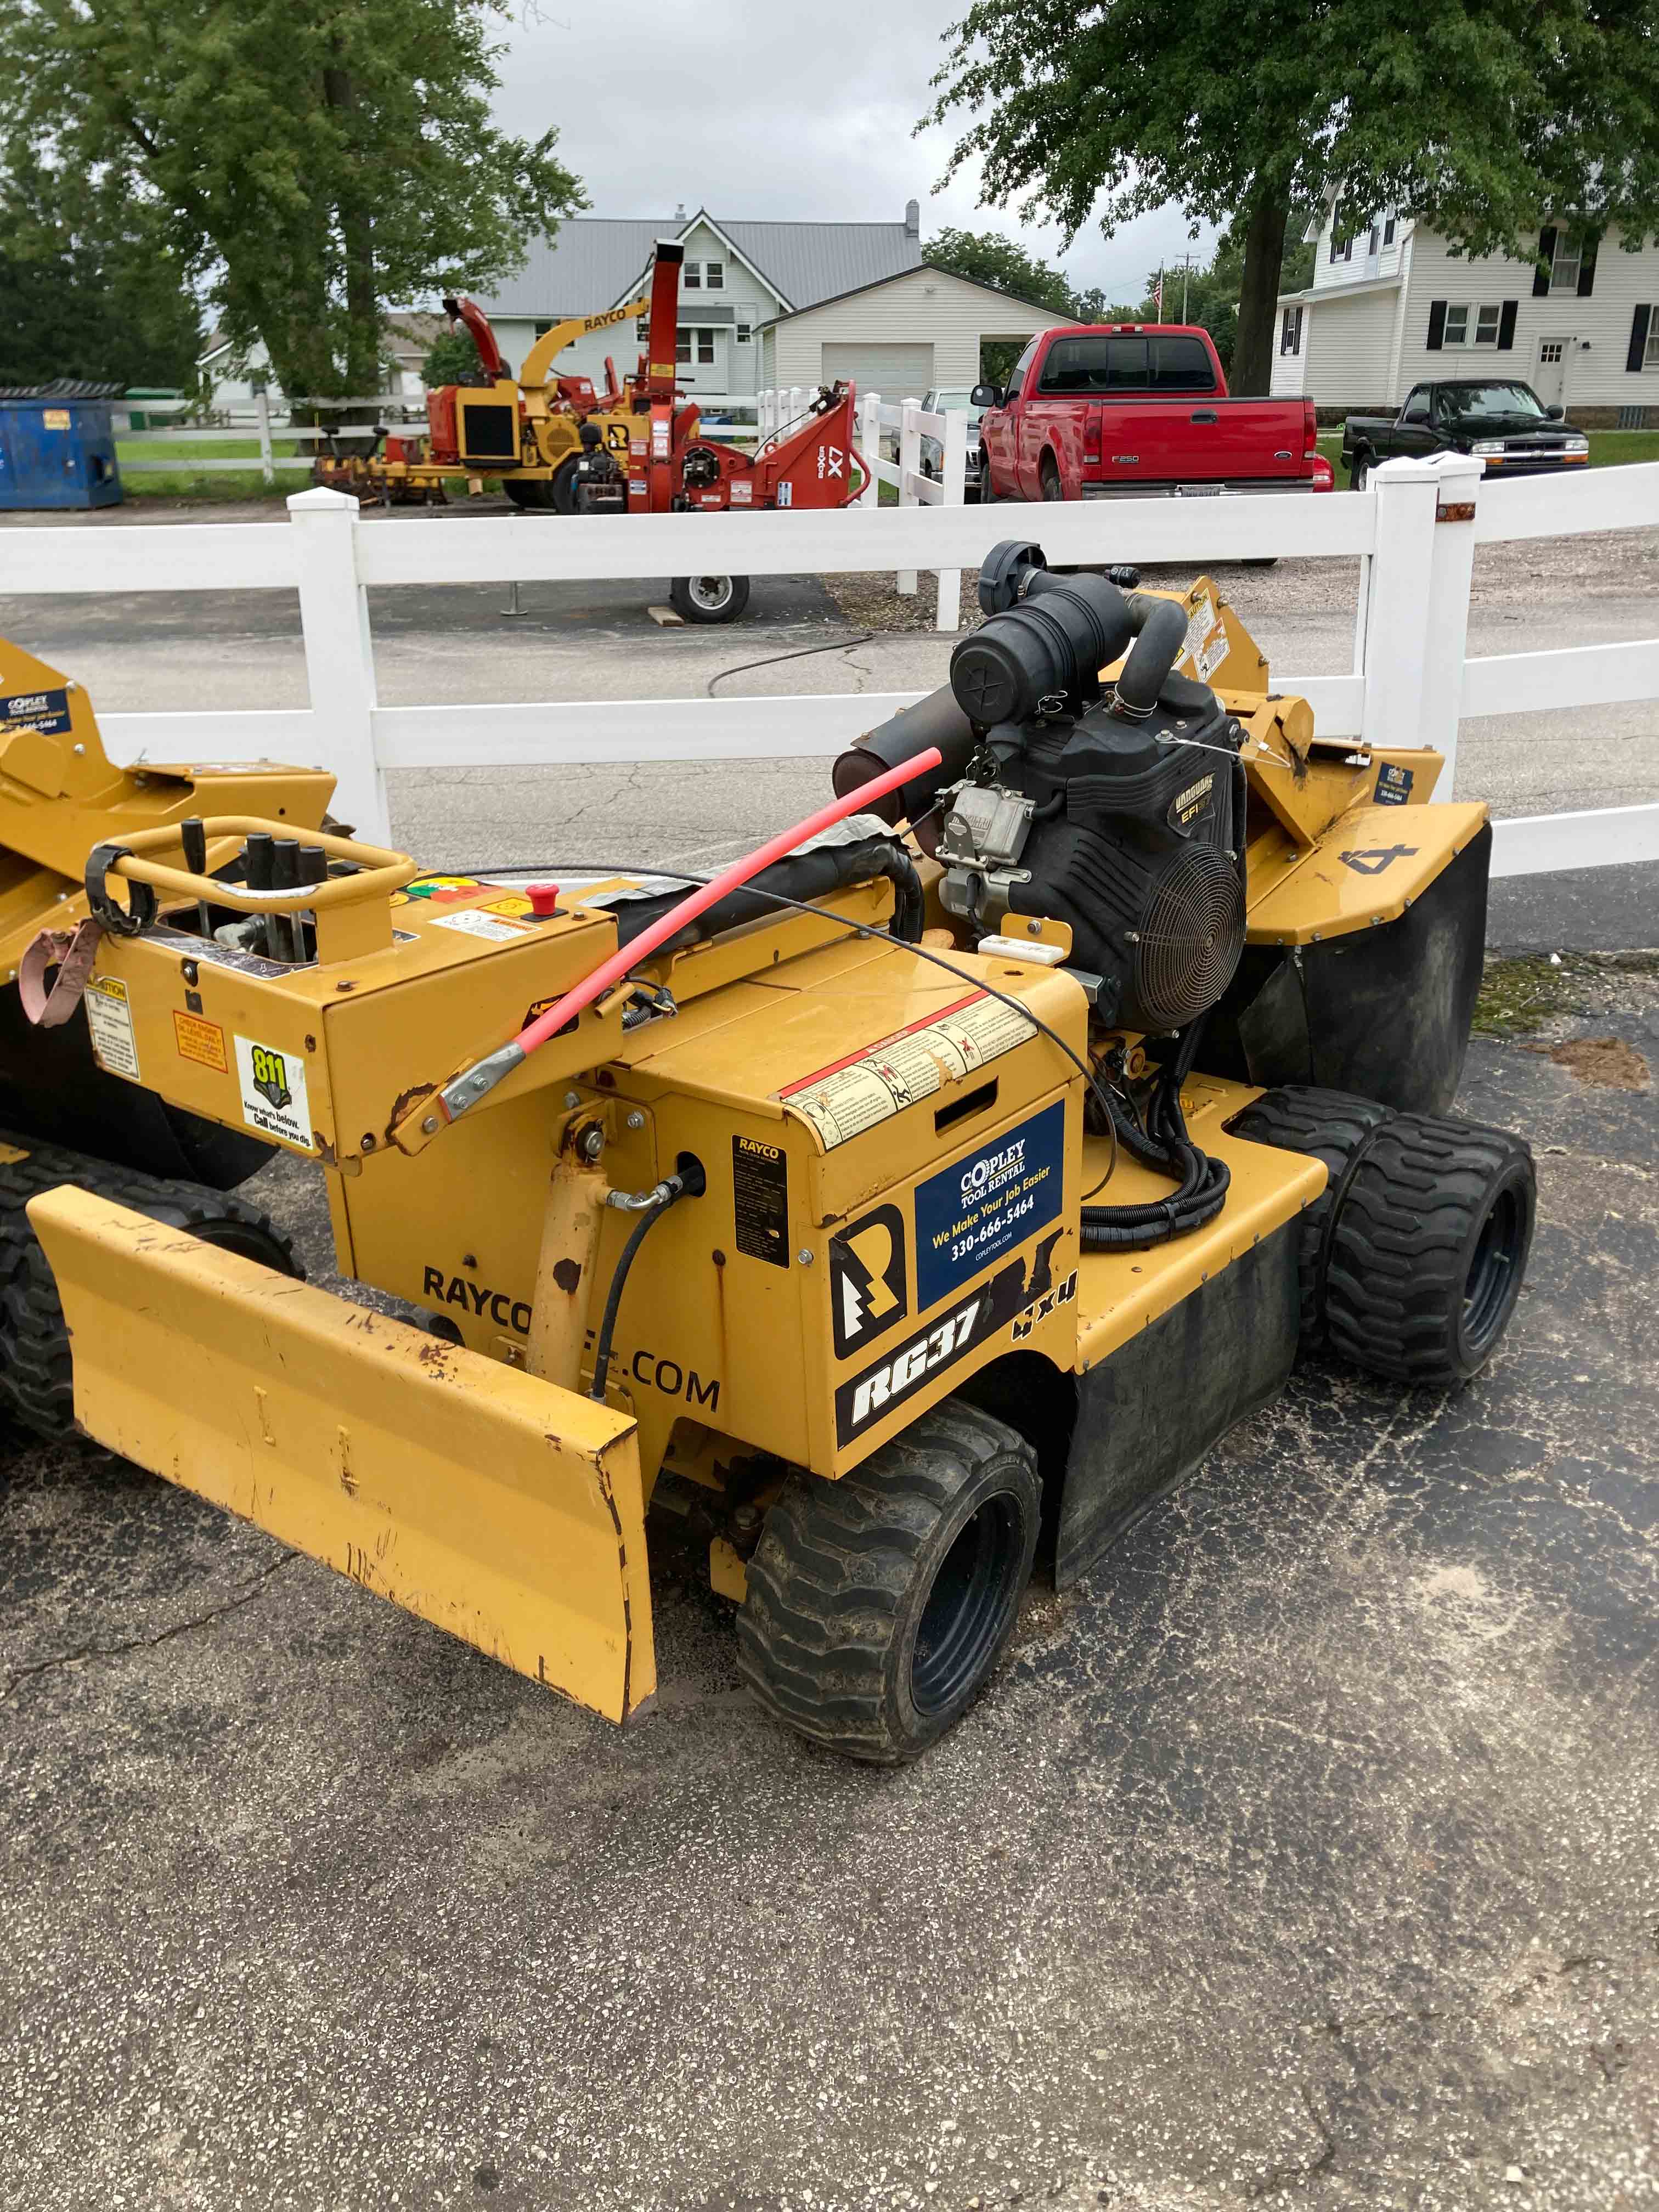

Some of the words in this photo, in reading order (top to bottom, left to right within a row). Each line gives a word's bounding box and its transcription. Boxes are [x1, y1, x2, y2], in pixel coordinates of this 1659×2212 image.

[584, 309, 626, 330] RAYCO
[817, 445, 826, 479] BOXER
[827, 446, 843, 478] X7
[1181, 803, 1198, 823] EFI
[873, 1030, 910, 1048] DANGER
[253, 1047, 286, 1090] 811
[244, 1101, 258, 1113] Know
[259, 1107, 275, 1120] what's
[276, 1111, 300, 1130] below.
[254, 1113, 269, 1128] Call
[269, 1123, 288, 1137] before
[289, 1131, 299, 1142] you
[300, 1135, 311, 1147] dig.
[739, 1138, 779, 1159] RAYCO
[961, 1138, 1025, 1192] COPLEY
[961, 1186, 987, 1209] TOOL
[988, 1161, 1025, 1193] RENTAL
[933, 1231, 950, 1249] We
[952, 1213, 979, 1238] Make
[981, 1197, 1003, 1218] Your
[1005, 1184, 1021, 1206] Job
[1023, 1166, 1051, 1192] Easier
[952, 1194, 1034, 1262] 330-666-5464
[975, 1232, 1012, 1261] COPLEYTOOL.COM
[851, 1299, 980, 1427] RG37
